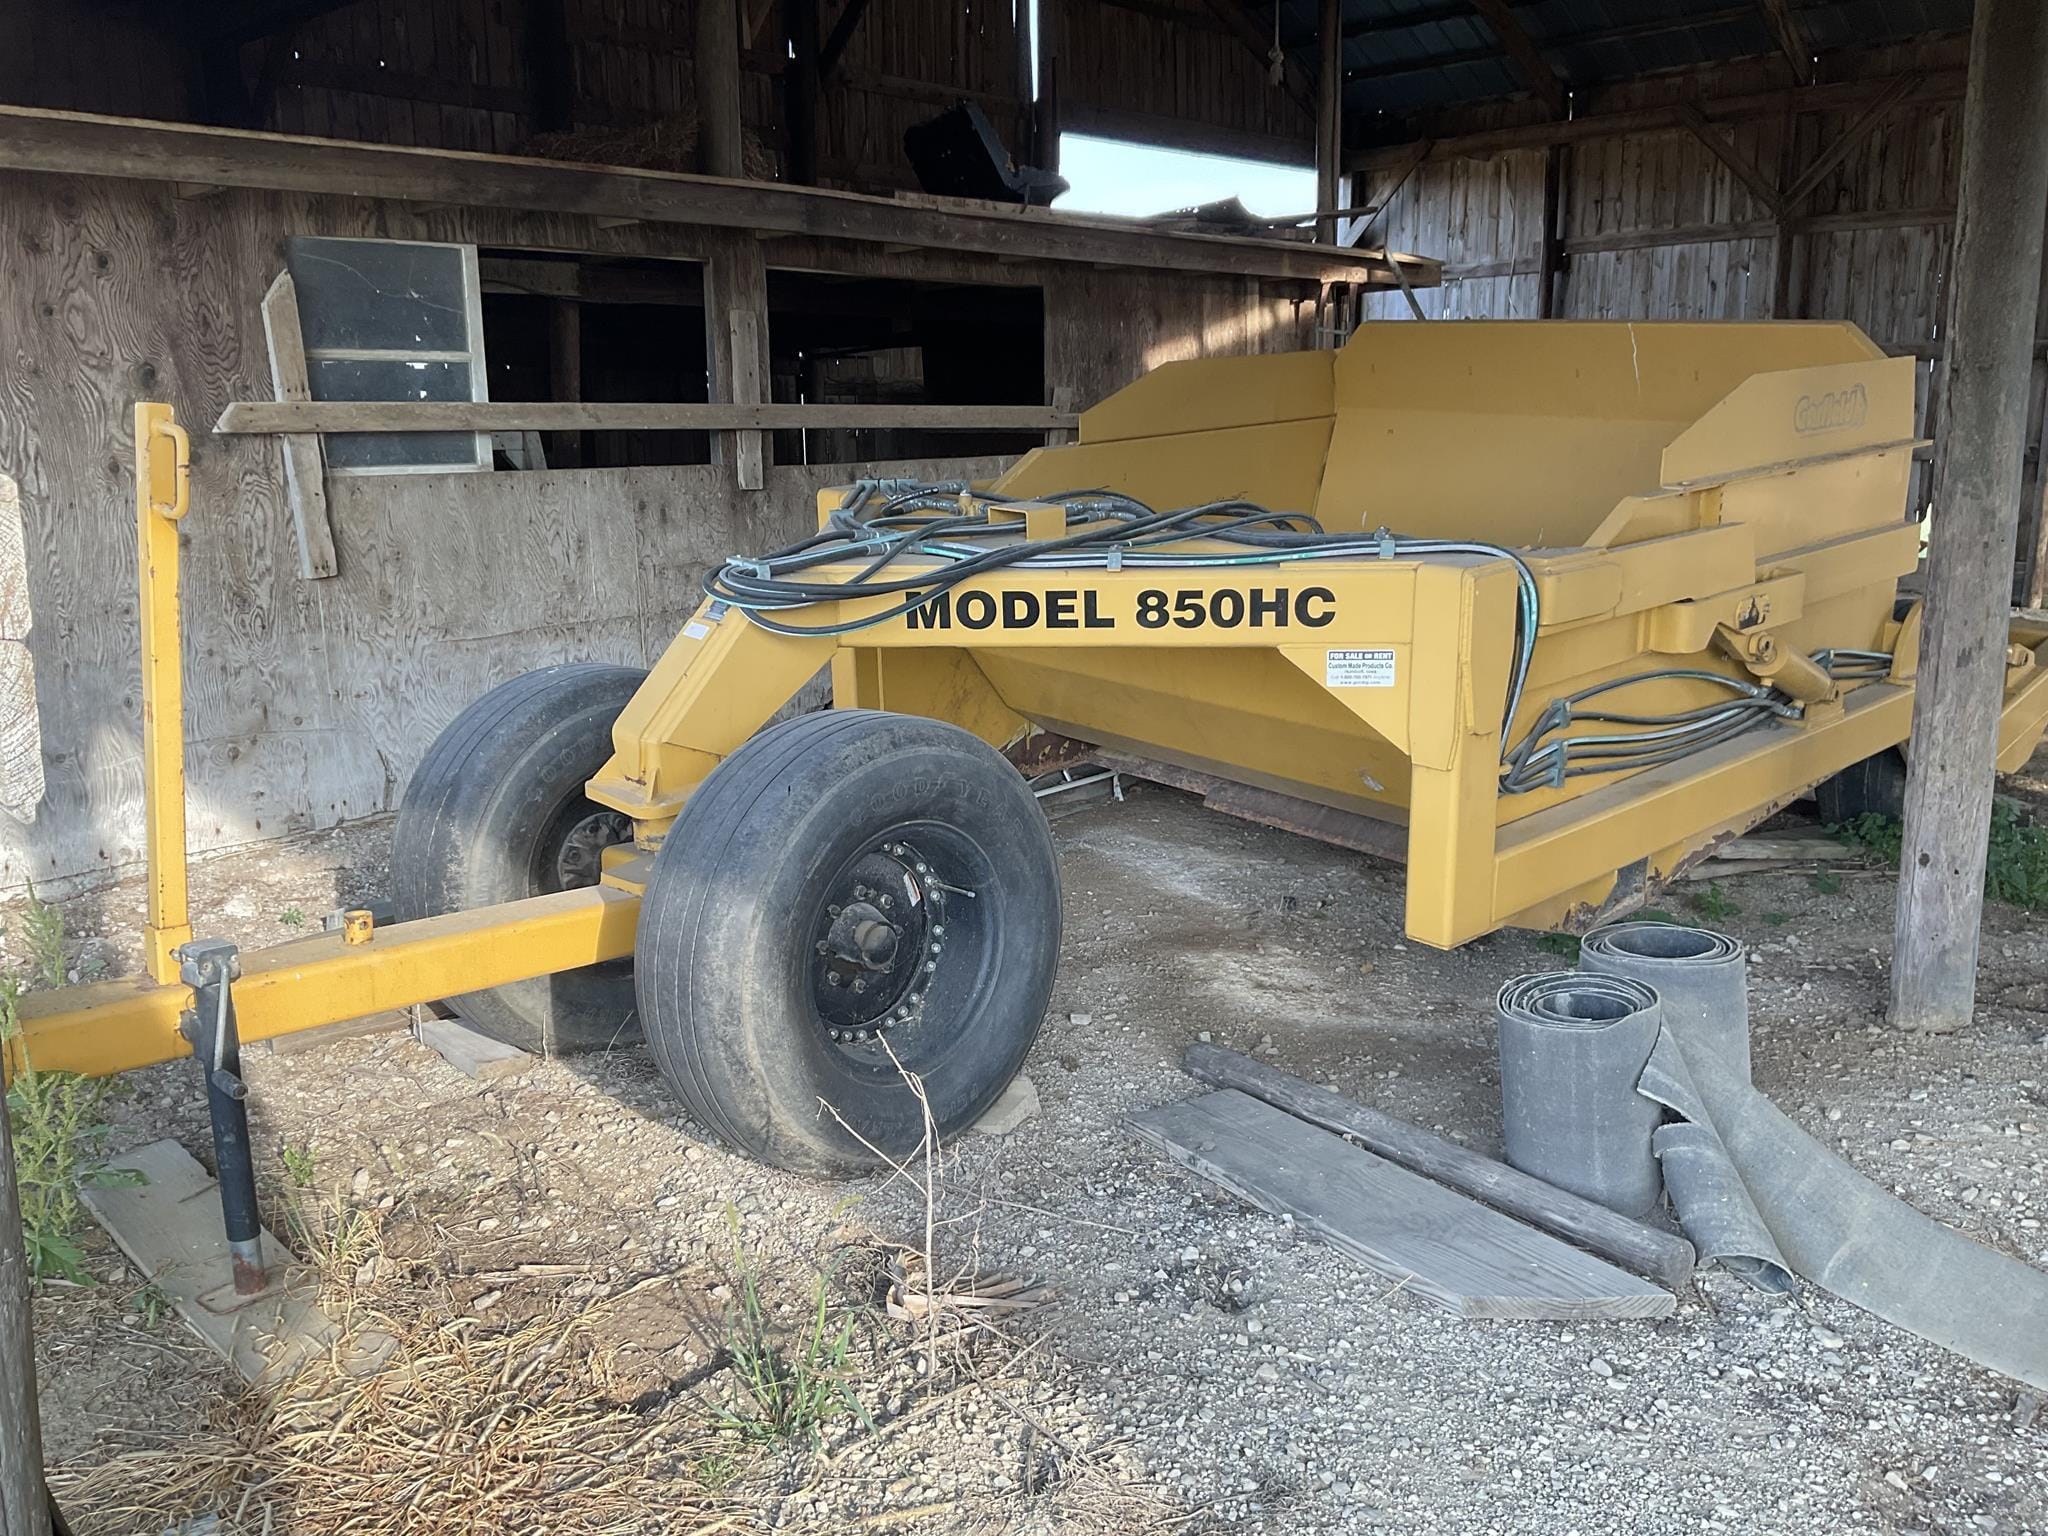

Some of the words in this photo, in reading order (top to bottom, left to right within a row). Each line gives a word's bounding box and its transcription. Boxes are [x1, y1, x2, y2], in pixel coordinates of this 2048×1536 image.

[905, 590, 1115, 629] MODEL
[1135, 587, 1336, 628] 850HC
[849, 776, 1024, 838] GOODYEAR
